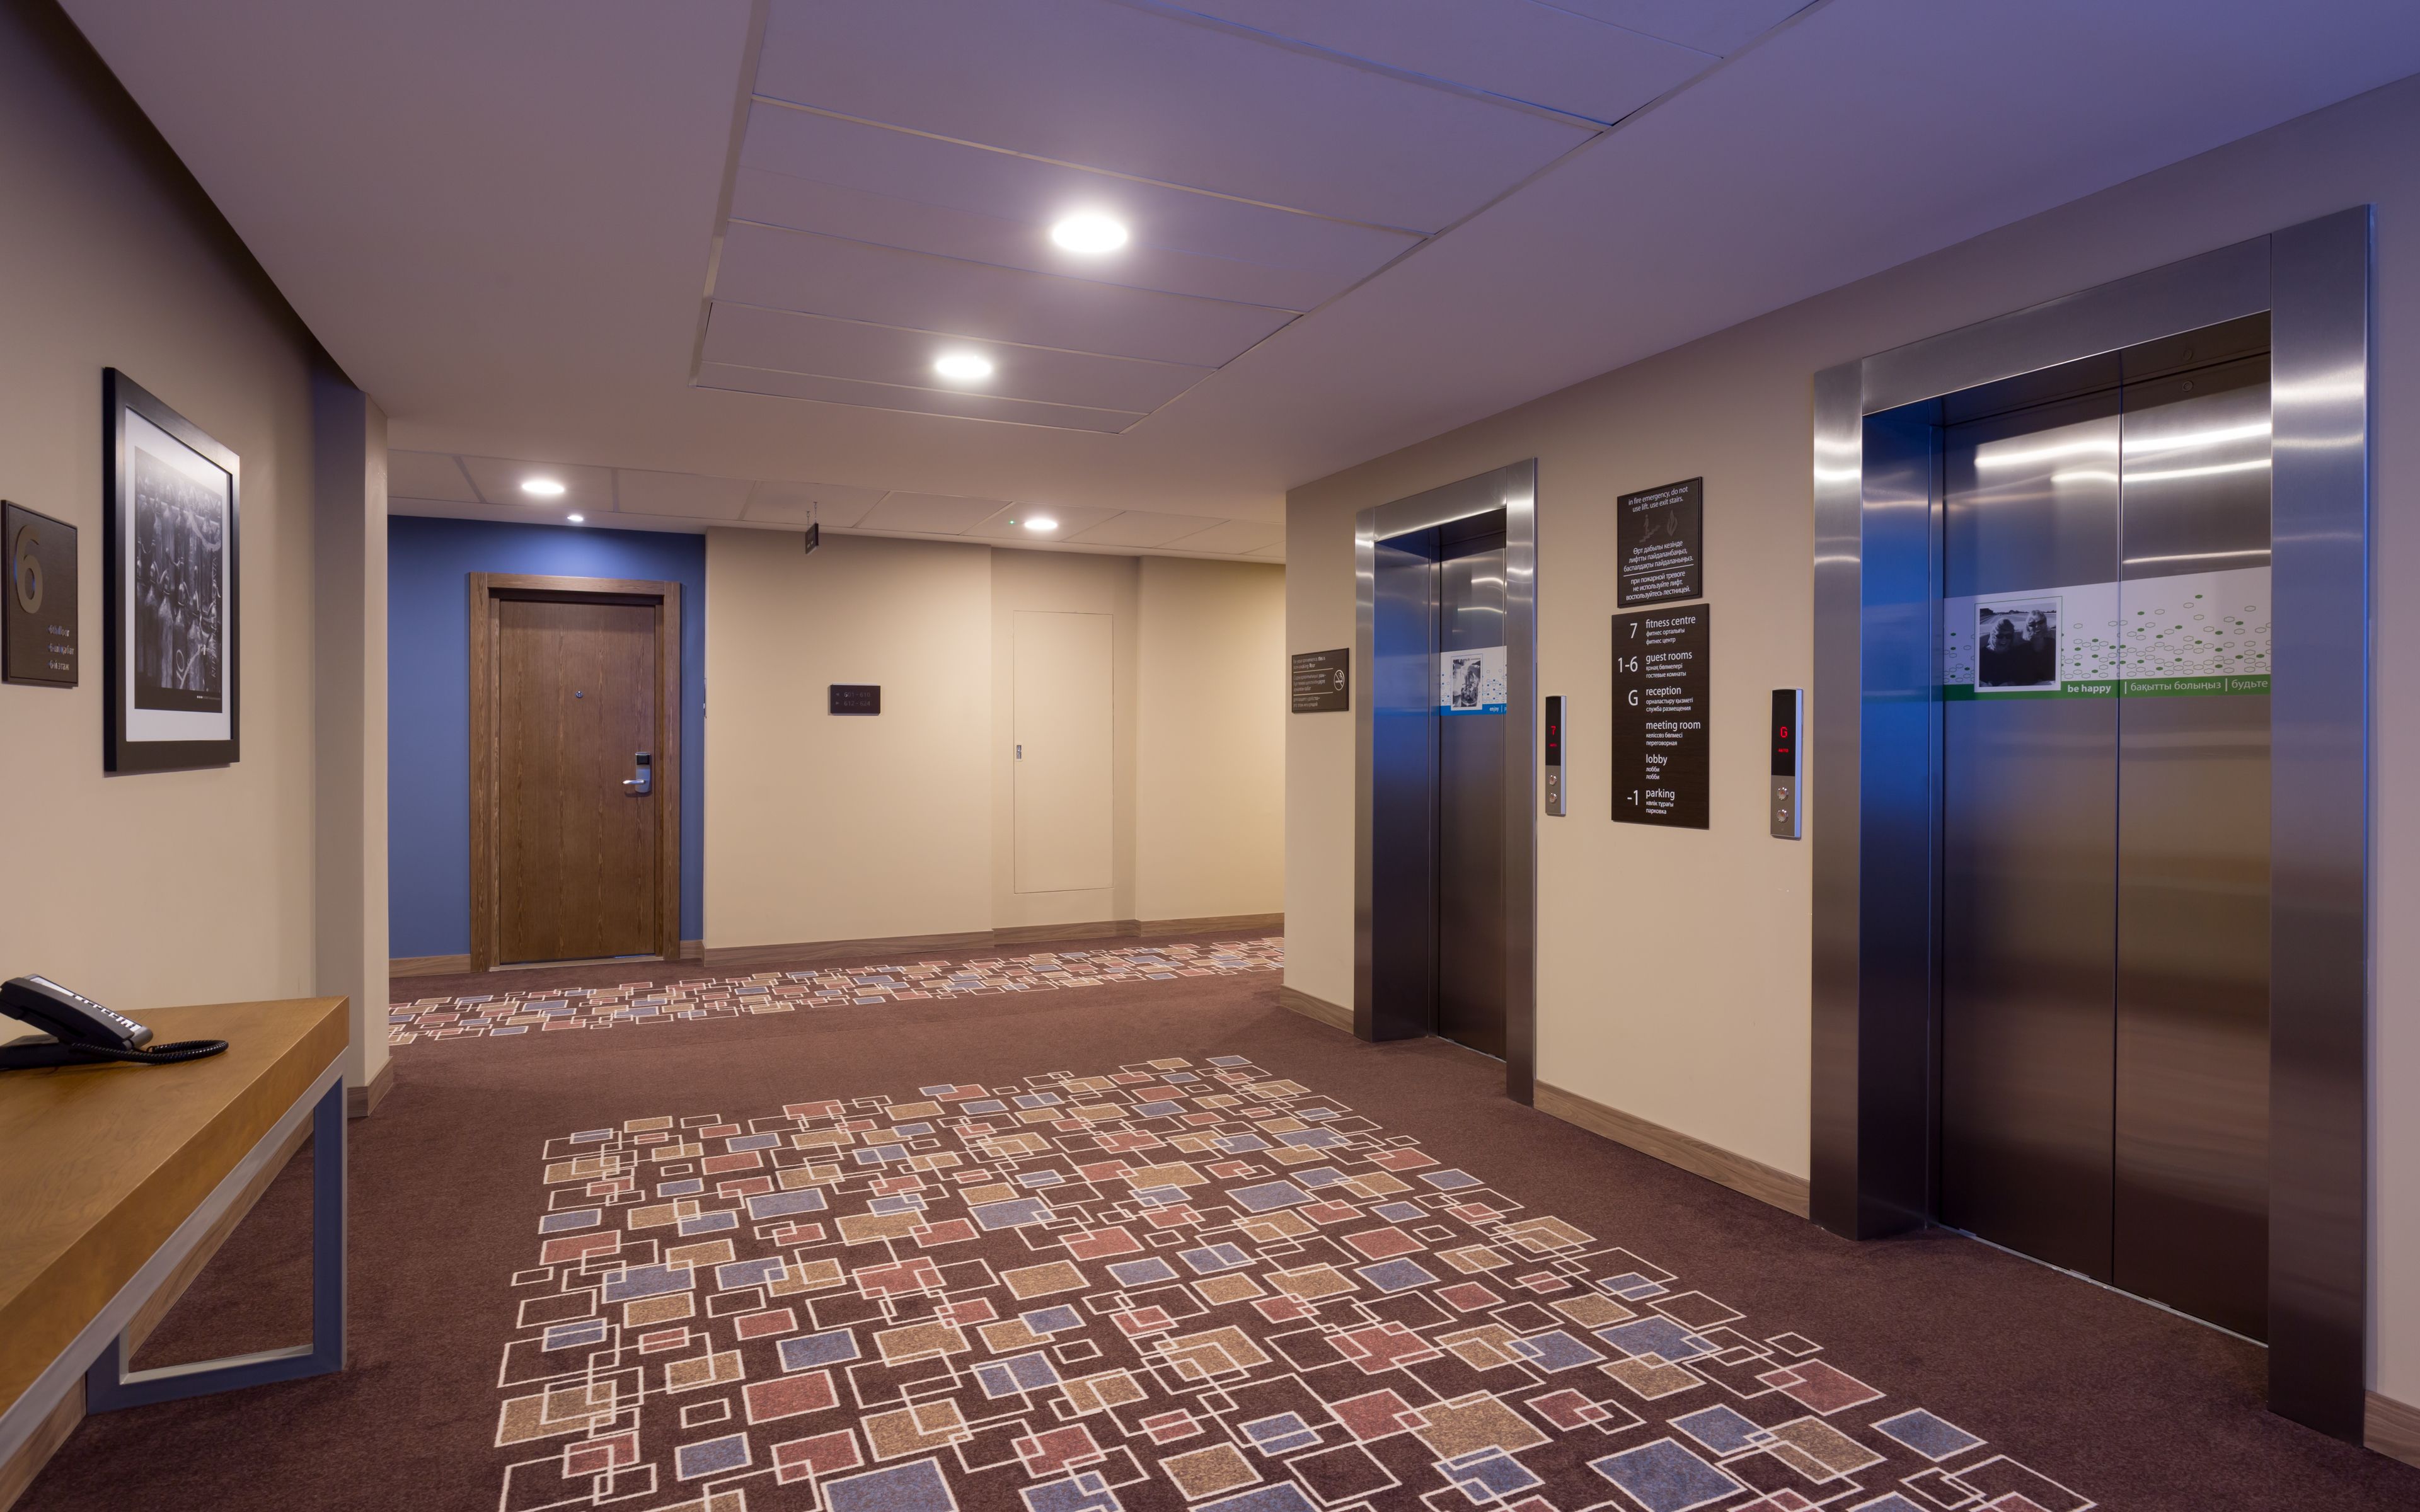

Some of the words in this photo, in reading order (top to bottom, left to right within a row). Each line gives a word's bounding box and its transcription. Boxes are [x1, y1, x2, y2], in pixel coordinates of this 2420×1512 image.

[14, 524, 43, 614] 6
[1641, 573, 1665, 583] пожарной
[1666, 571, 1685, 580] тревоге
[1640, 581, 1669, 591] используйте
[1626, 591, 1662, 600] воспользуйтесь
[1630, 622, 1637, 639] 7
[1646, 619, 1670, 629] fitness
[1671, 616, 1696, 626] centre
[1618, 656, 1639, 673] 1-6
[1646, 653, 1666, 664] guest
[1668, 651, 1693, 660] rooms
[2067, 684, 2080, 692] be
[2081, 684, 2111, 694] happy
[2130, 682, 2172, 692] бақытты
[2174, 681, 2221, 691] болыңыз
[2231, 679, 2268, 689] будьте
[1628, 689, 1639, 706] G
[1646, 686, 1681, 697] reception
[1550, 725, 1557, 736] 7
[1646, 721, 1678, 731] meeting
[1780, 726, 1788, 738] G
[1646, 753, 1668, 766] lobby
[1627, 790, 1639, 805] -1
[1646, 789, 1675, 800] parking
